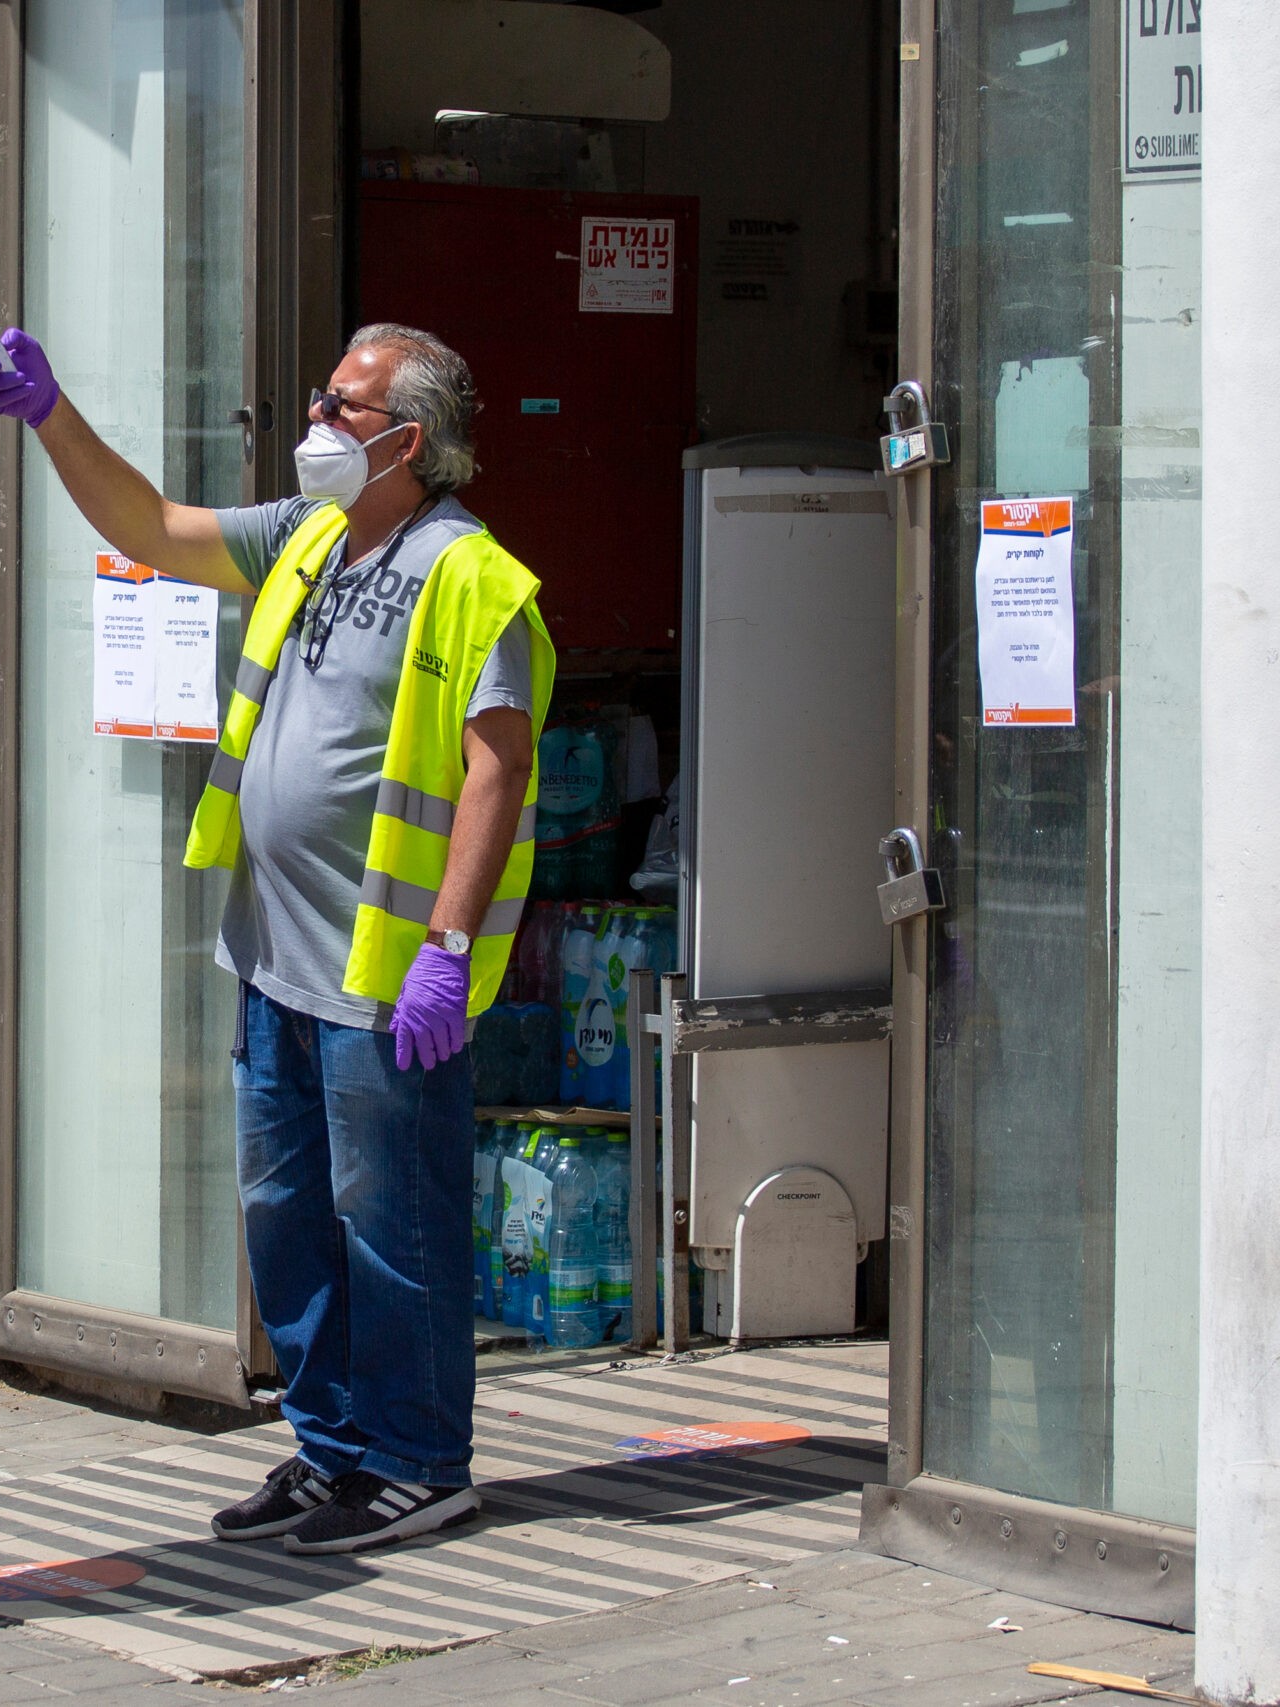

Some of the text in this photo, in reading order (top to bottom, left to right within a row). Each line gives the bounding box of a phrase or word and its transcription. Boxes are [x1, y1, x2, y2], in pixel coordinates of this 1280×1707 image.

[589, 226, 669, 248] עמדת
[588, 248, 669, 270] כיבוי אש
[1002, 503, 1040, 525] ויקטורי
